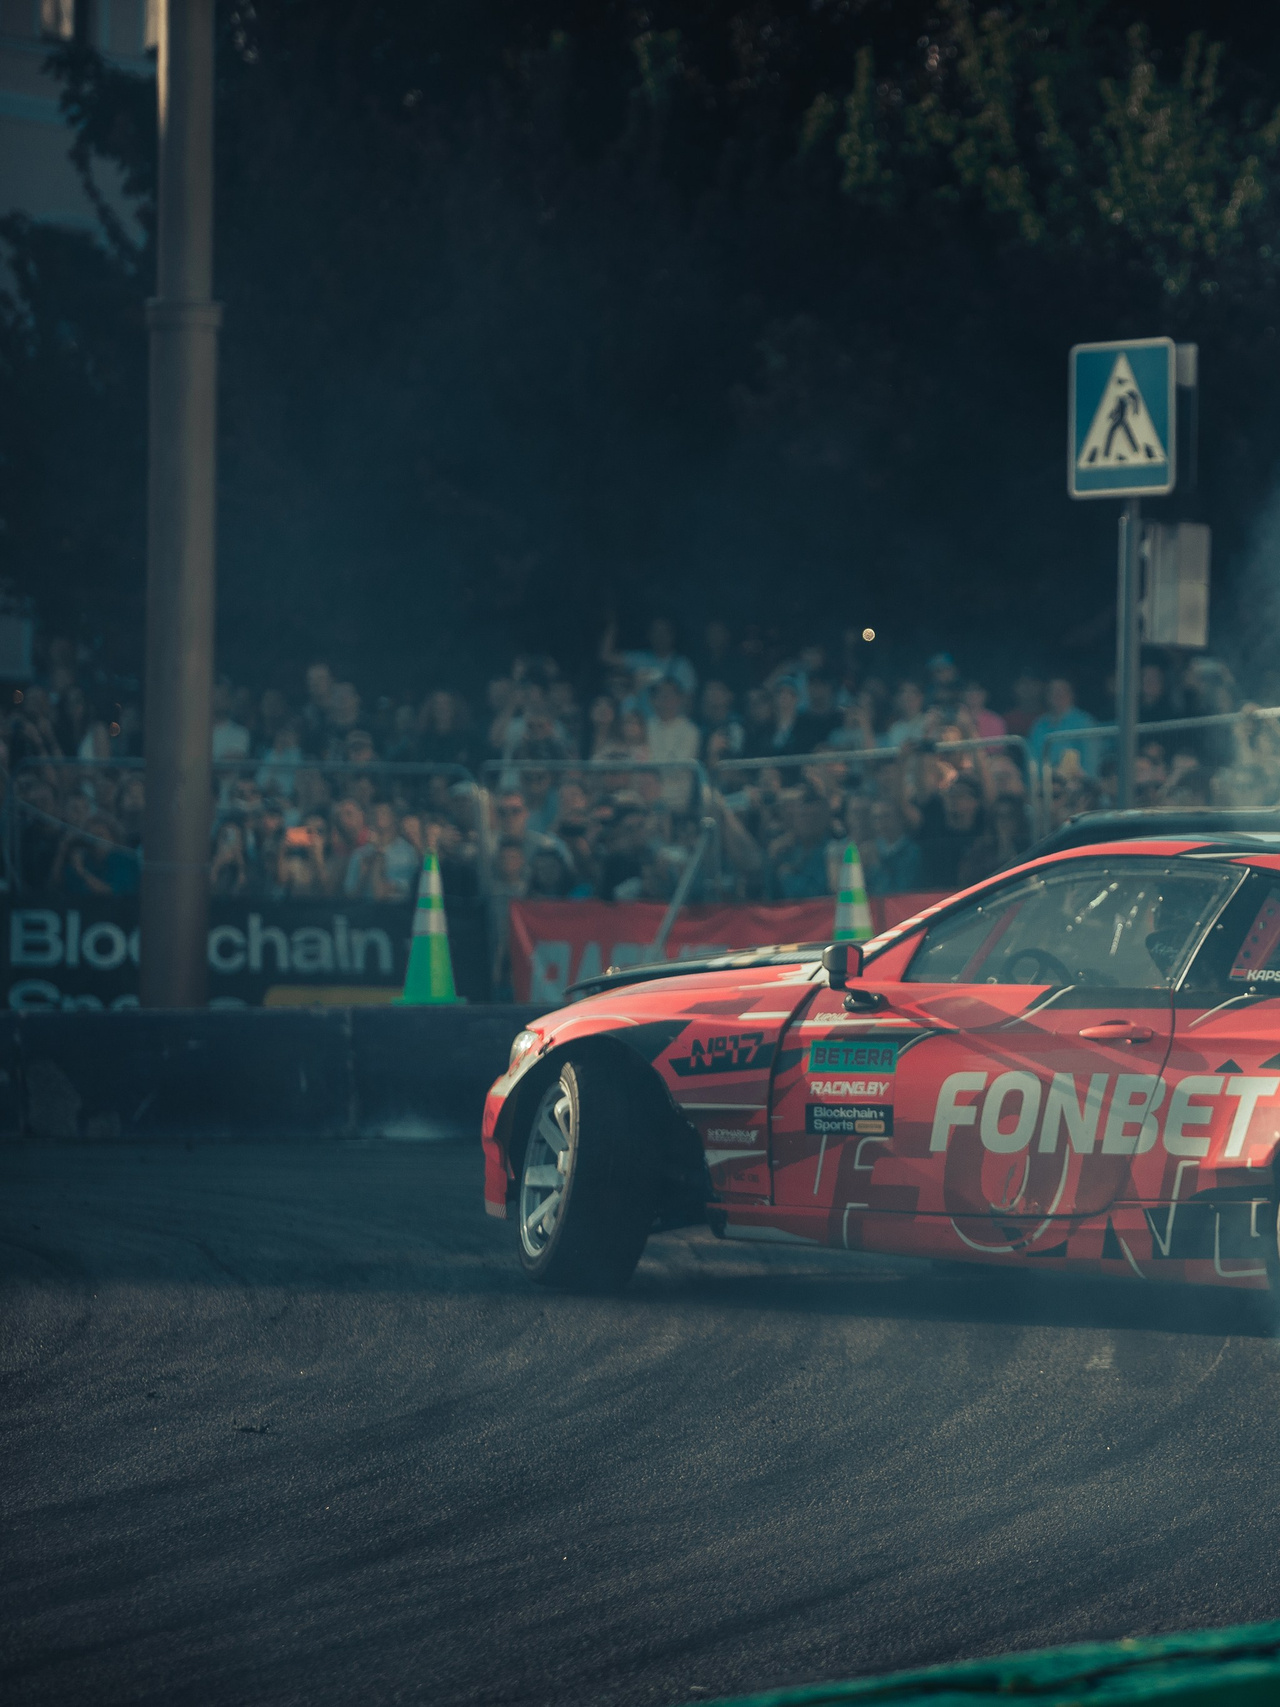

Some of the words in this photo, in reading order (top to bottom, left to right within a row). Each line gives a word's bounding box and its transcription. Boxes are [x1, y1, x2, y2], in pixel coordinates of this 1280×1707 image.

[9, 908, 394, 976] Blochain
[814, 1047, 894, 1067] BET.ERA
[810, 1081, 890, 1097] RACING.BY
[814, 1107, 878, 1119] Blockchain
[929, 1070, 1280, 1158] FONBET
[814, 1119, 854, 1132] Sports
